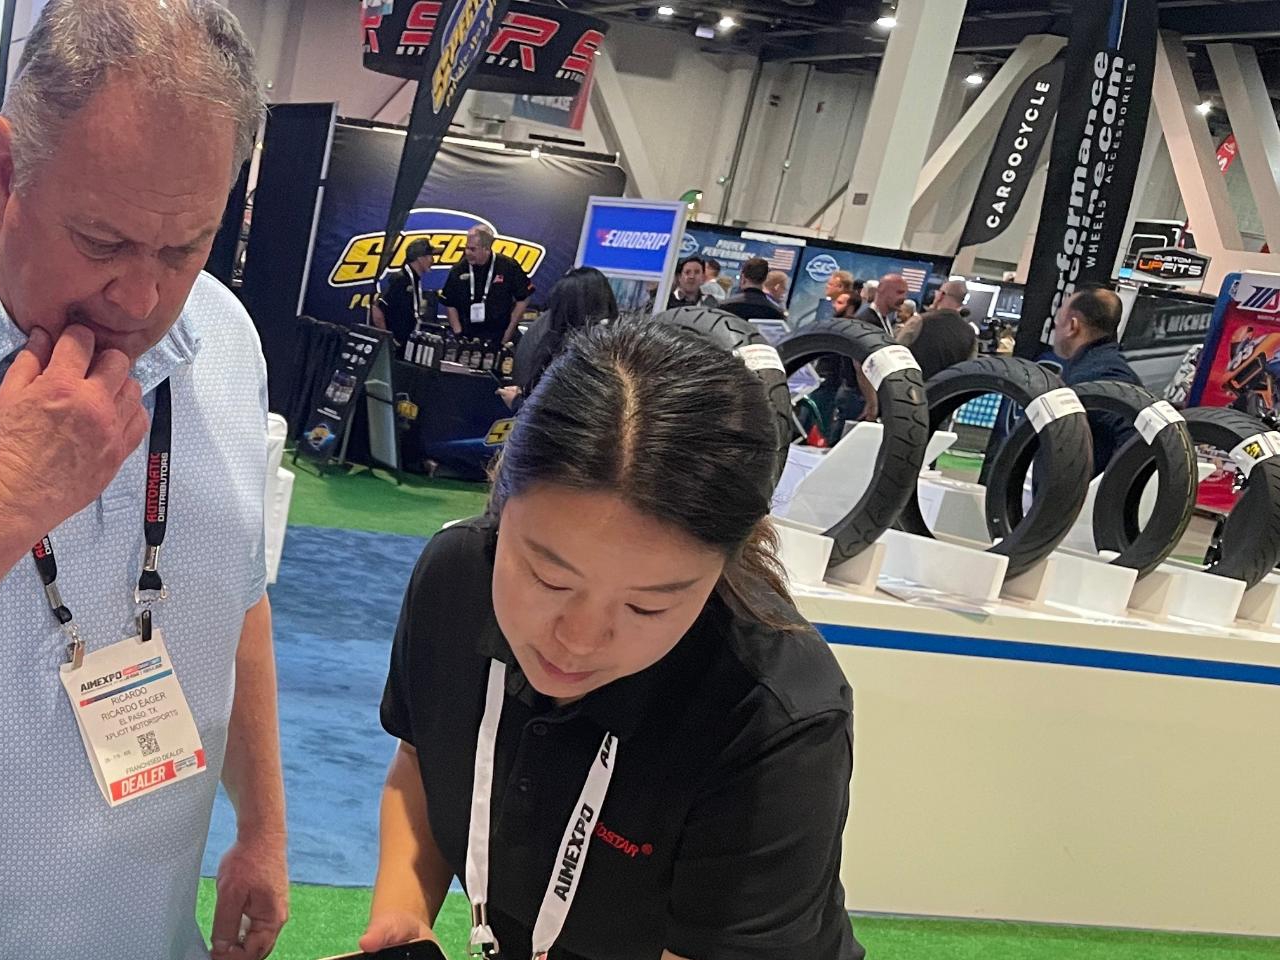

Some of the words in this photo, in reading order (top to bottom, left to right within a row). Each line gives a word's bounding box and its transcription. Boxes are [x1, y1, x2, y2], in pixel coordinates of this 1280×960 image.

[986, 81, 1050, 228] CARGOCYCLE
[1086, 200, 1107, 269] WHEELS
[1104, 63, 1136, 184] ACCESSORIES
[1039, 51, 1109, 345] Performance
[1048, 56, 1124, 346] achine.com
[602, 229, 670, 250] EUROGRIP
[1153, 254, 1192, 264] CUSTOM
[146, 452, 161, 522] AUTOMATIC
[157, 452, 169, 522] DISTRIBUTORS
[80, 670, 122, 693] AIMEXPO
[110, 686, 147, 706] RICARDO
[101, 704, 138, 721] RICARDO
[121, 765, 167, 796] DEALER
[553, 803, 594, 902] AIMEXPO
[594, 822, 640, 858] DSTAR
